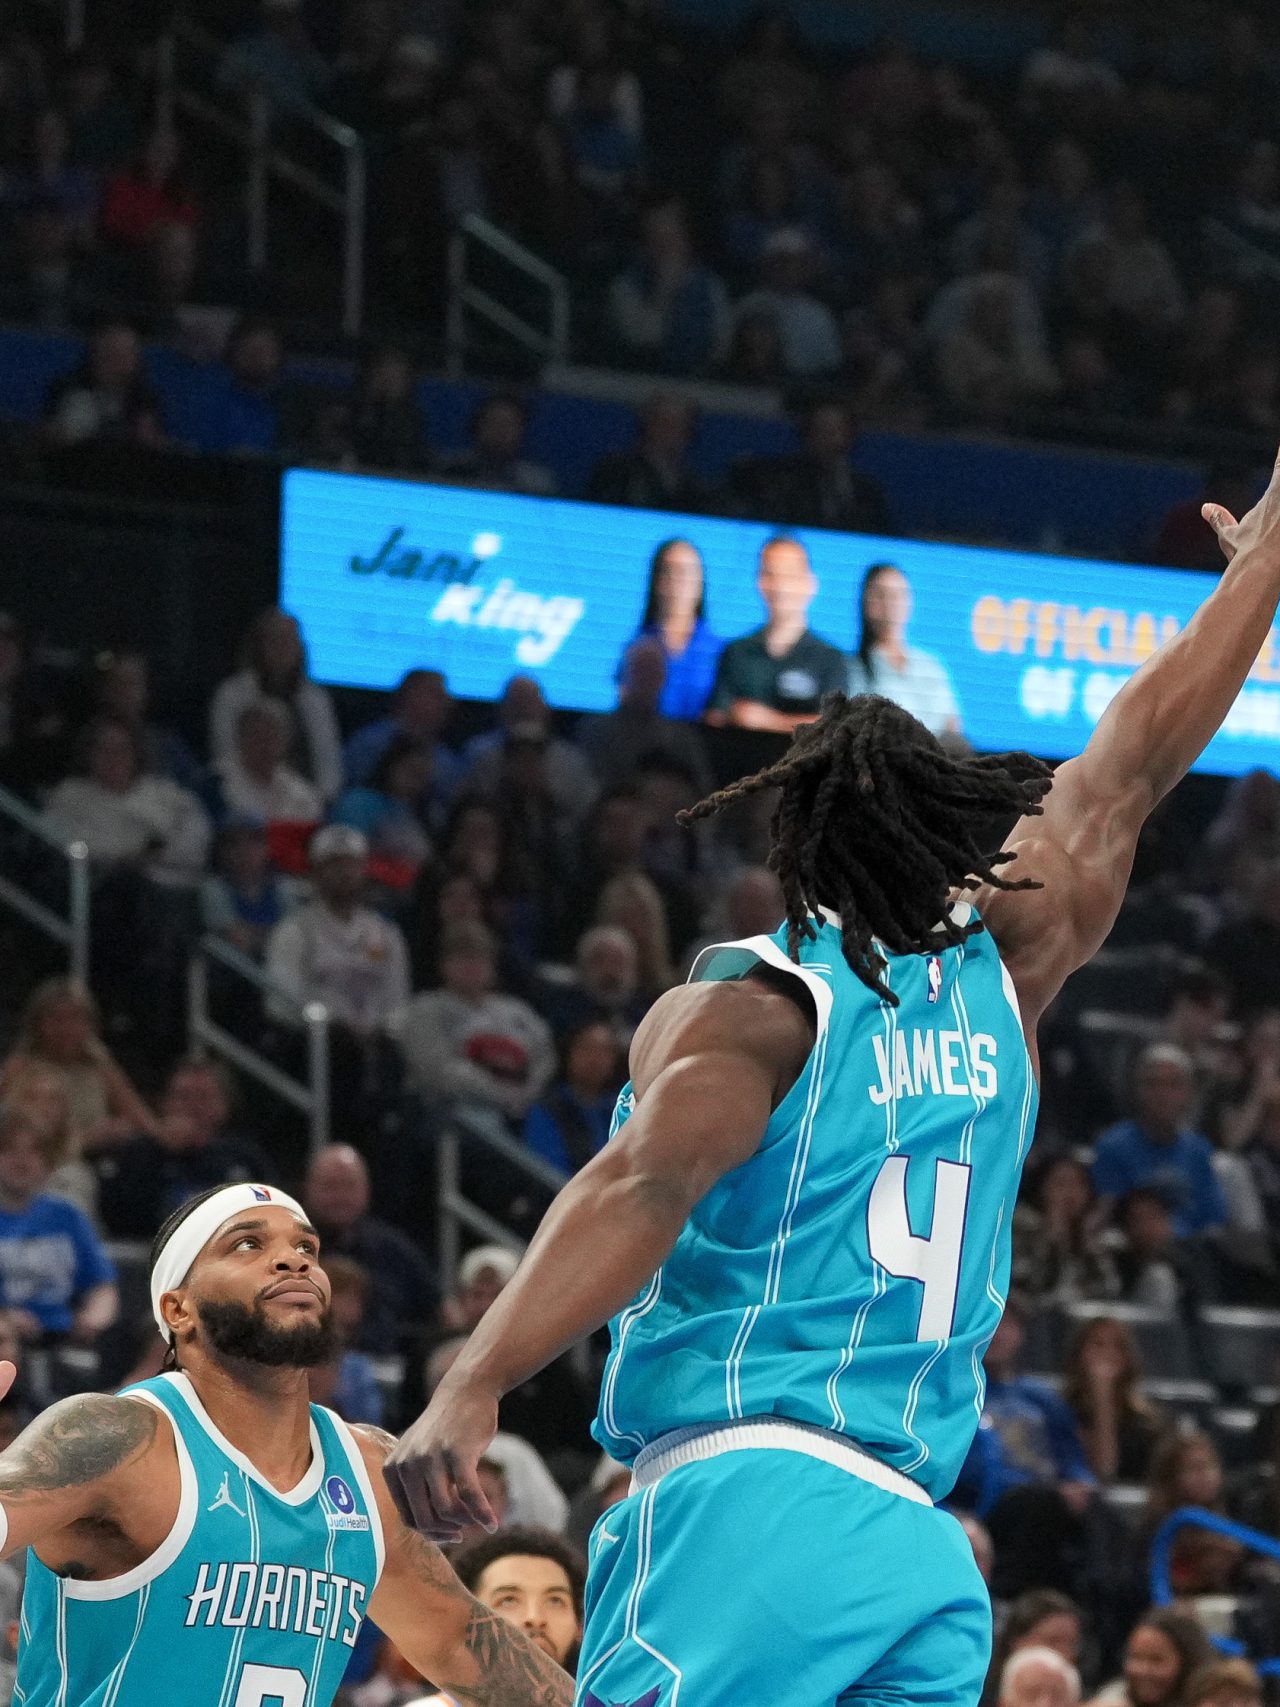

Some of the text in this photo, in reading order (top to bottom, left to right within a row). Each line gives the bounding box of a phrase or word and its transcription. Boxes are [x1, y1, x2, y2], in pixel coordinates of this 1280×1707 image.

[867, 1028, 998, 1106] JAMES
[865, 1154, 973, 1344] 4
[183, 1561, 367, 1649] HORNETS
